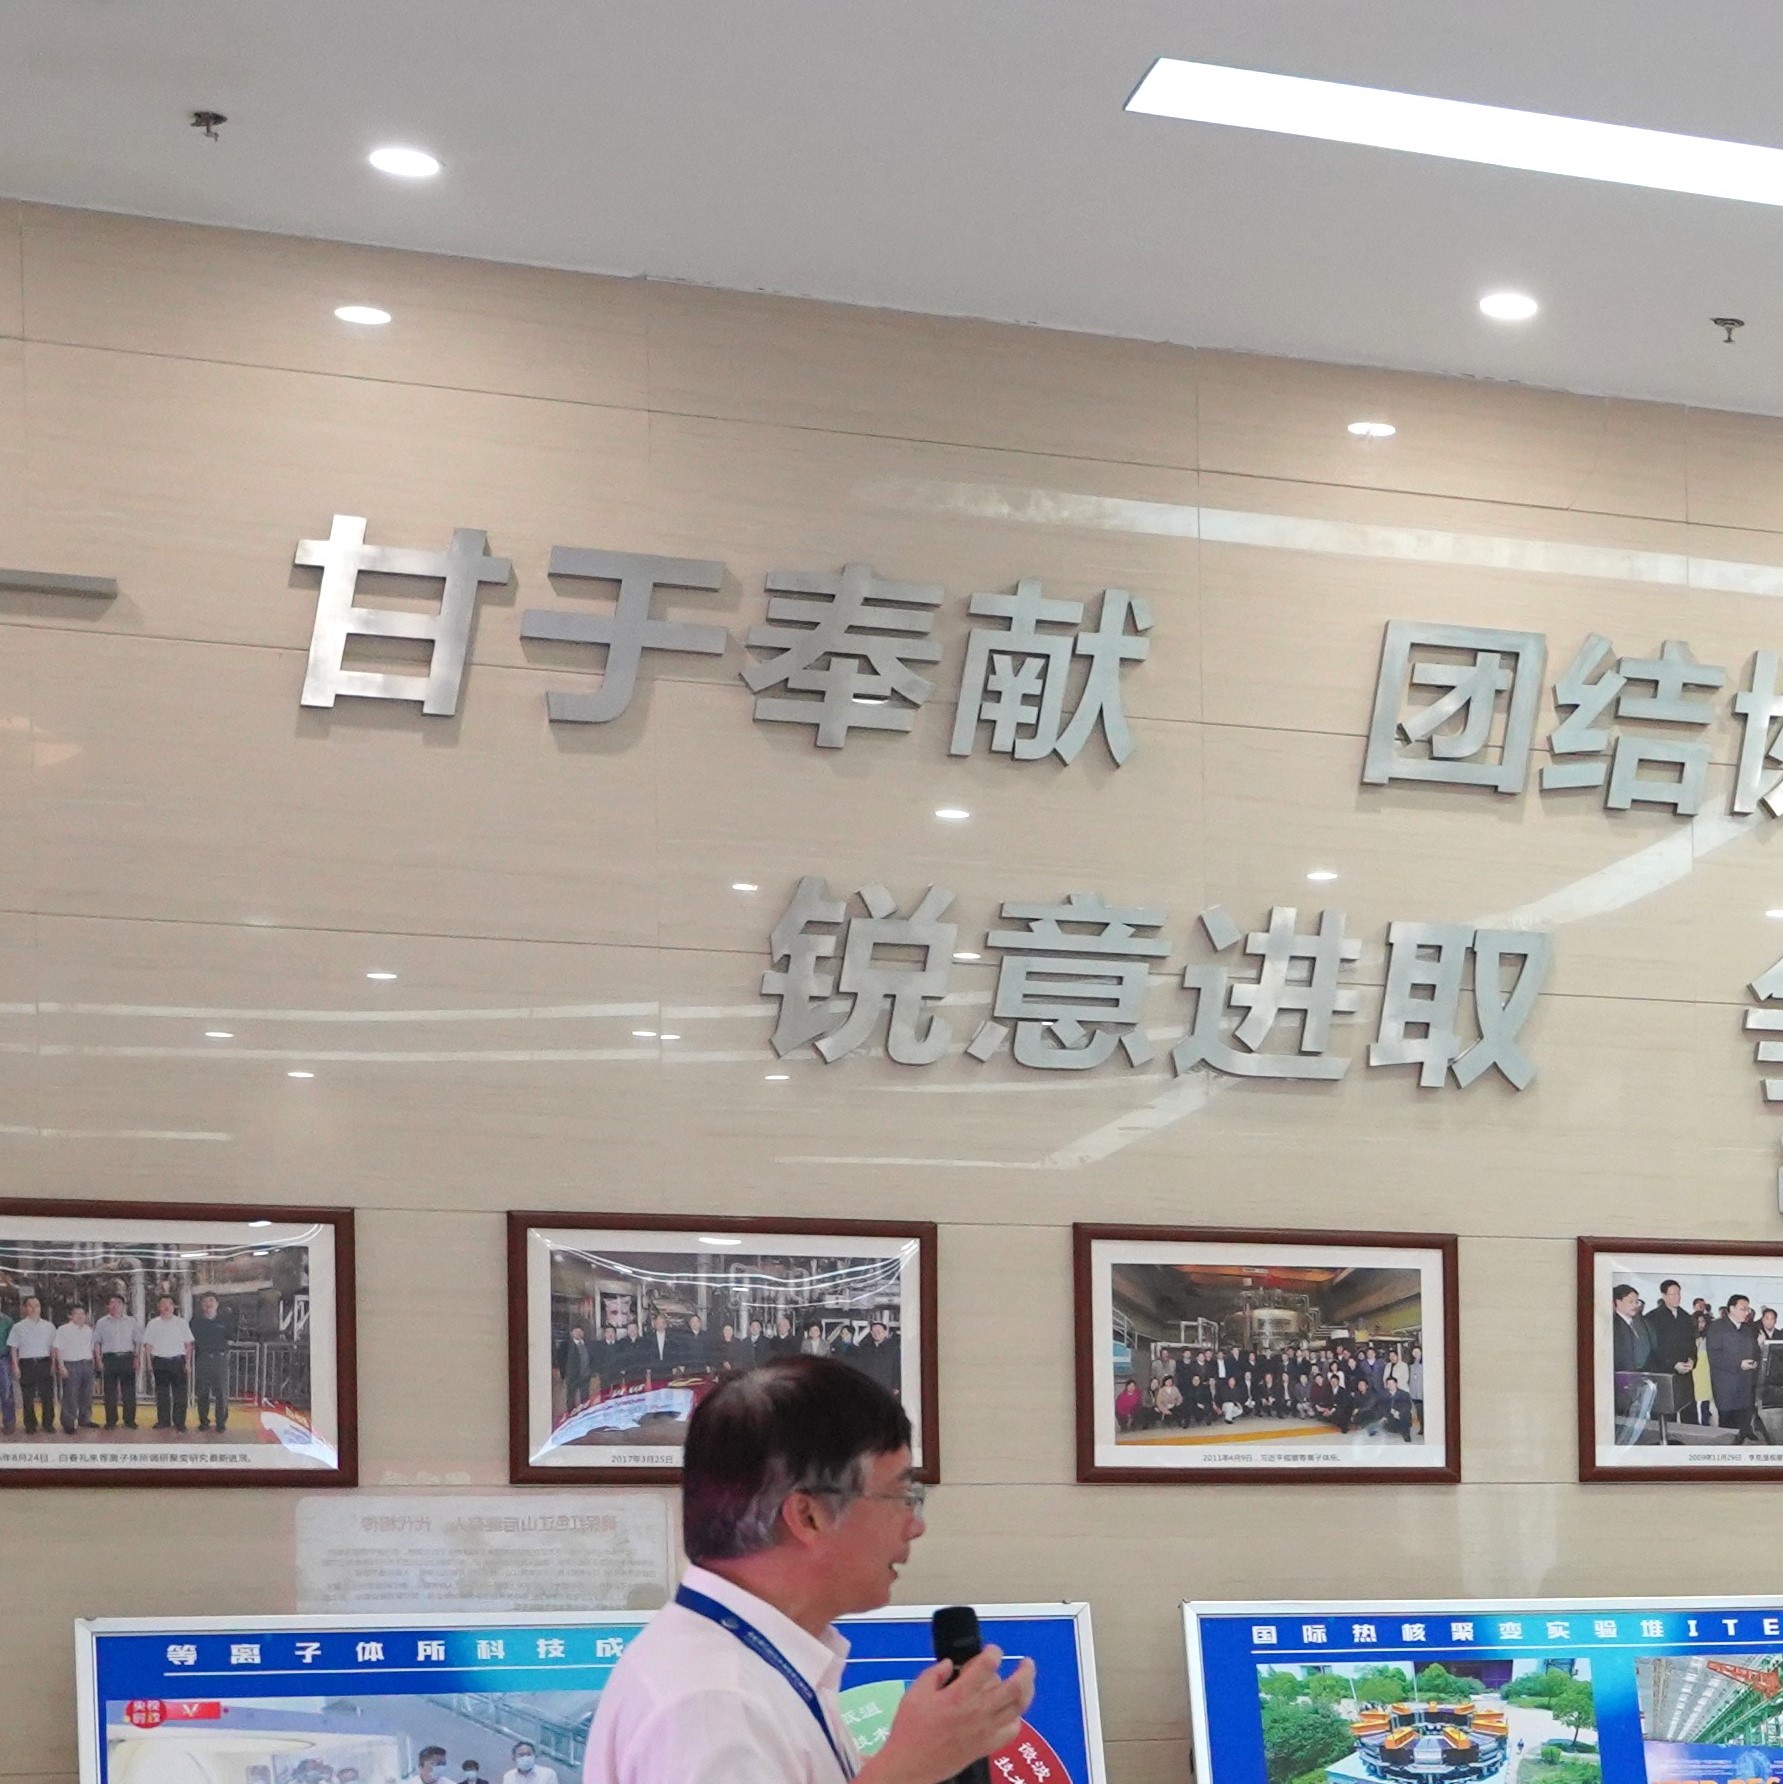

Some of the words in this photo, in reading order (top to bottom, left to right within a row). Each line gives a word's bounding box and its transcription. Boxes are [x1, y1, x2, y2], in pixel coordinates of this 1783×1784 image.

[289, 512, 1158, 770] 甘于奉献
[761, 873, 1556, 1092] 锐意进取
